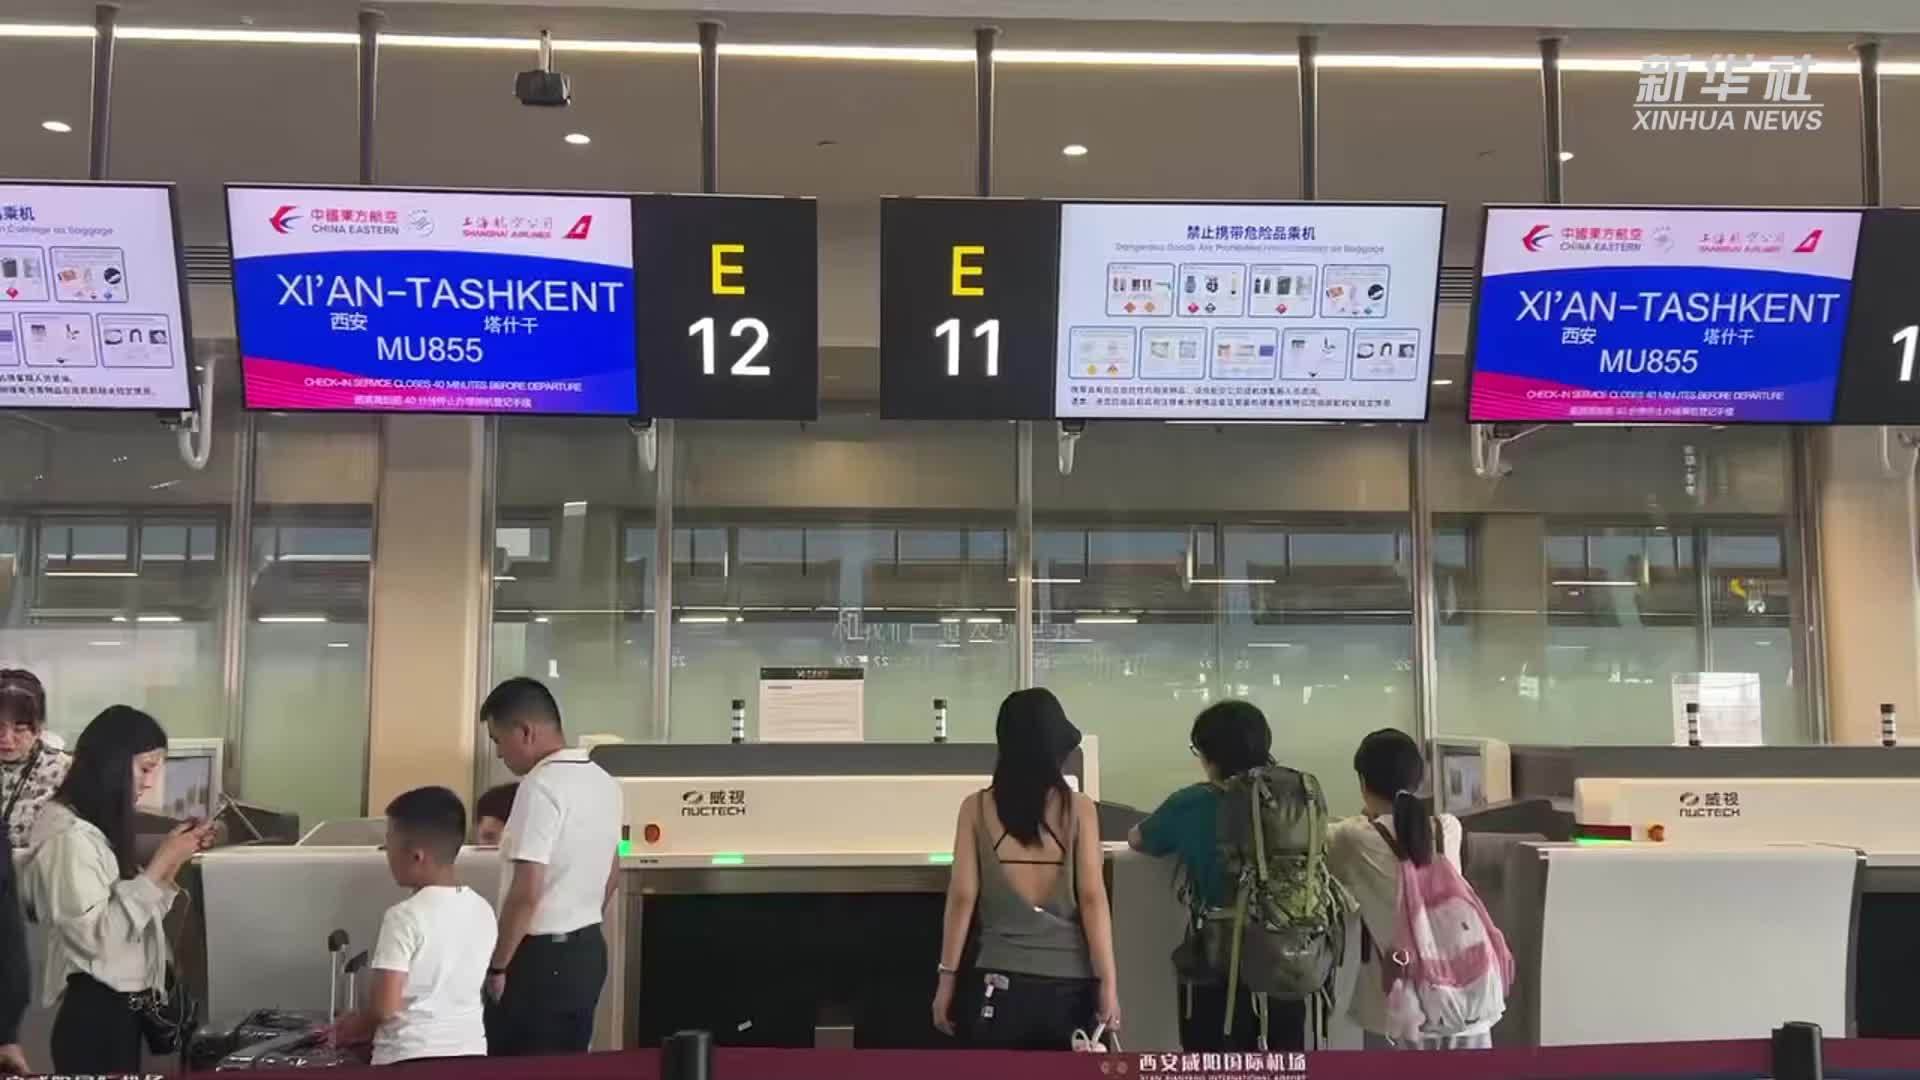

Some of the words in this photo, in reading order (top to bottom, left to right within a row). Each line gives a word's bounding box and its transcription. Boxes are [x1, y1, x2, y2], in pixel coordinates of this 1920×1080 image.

[311, 224, 347, 235] CHINA
[348, 225, 400, 236] EASTERN
[1186, 225, 1316, 241] 禁止携带危险品乘机
[712, 244, 745, 294] E
[952, 246, 985, 296] E
[330, 312, 369, 332] 西安
[483, 316, 539, 335] 塔什干
[688, 317, 771, 376] 12
[934, 318, 1000, 376] 11
[1560, 327, 1598, 345] 西安
[1703, 327, 1756, 346] 塔什干
[376, 336, 484, 363] MU855
[1599, 349, 1700, 374] MU855
[527, 382, 583, 393] DEPARTURE
[681, 806, 746, 817] NUCTECH
[1139, 1052, 1307, 1072] 西安咸阳国际机场
